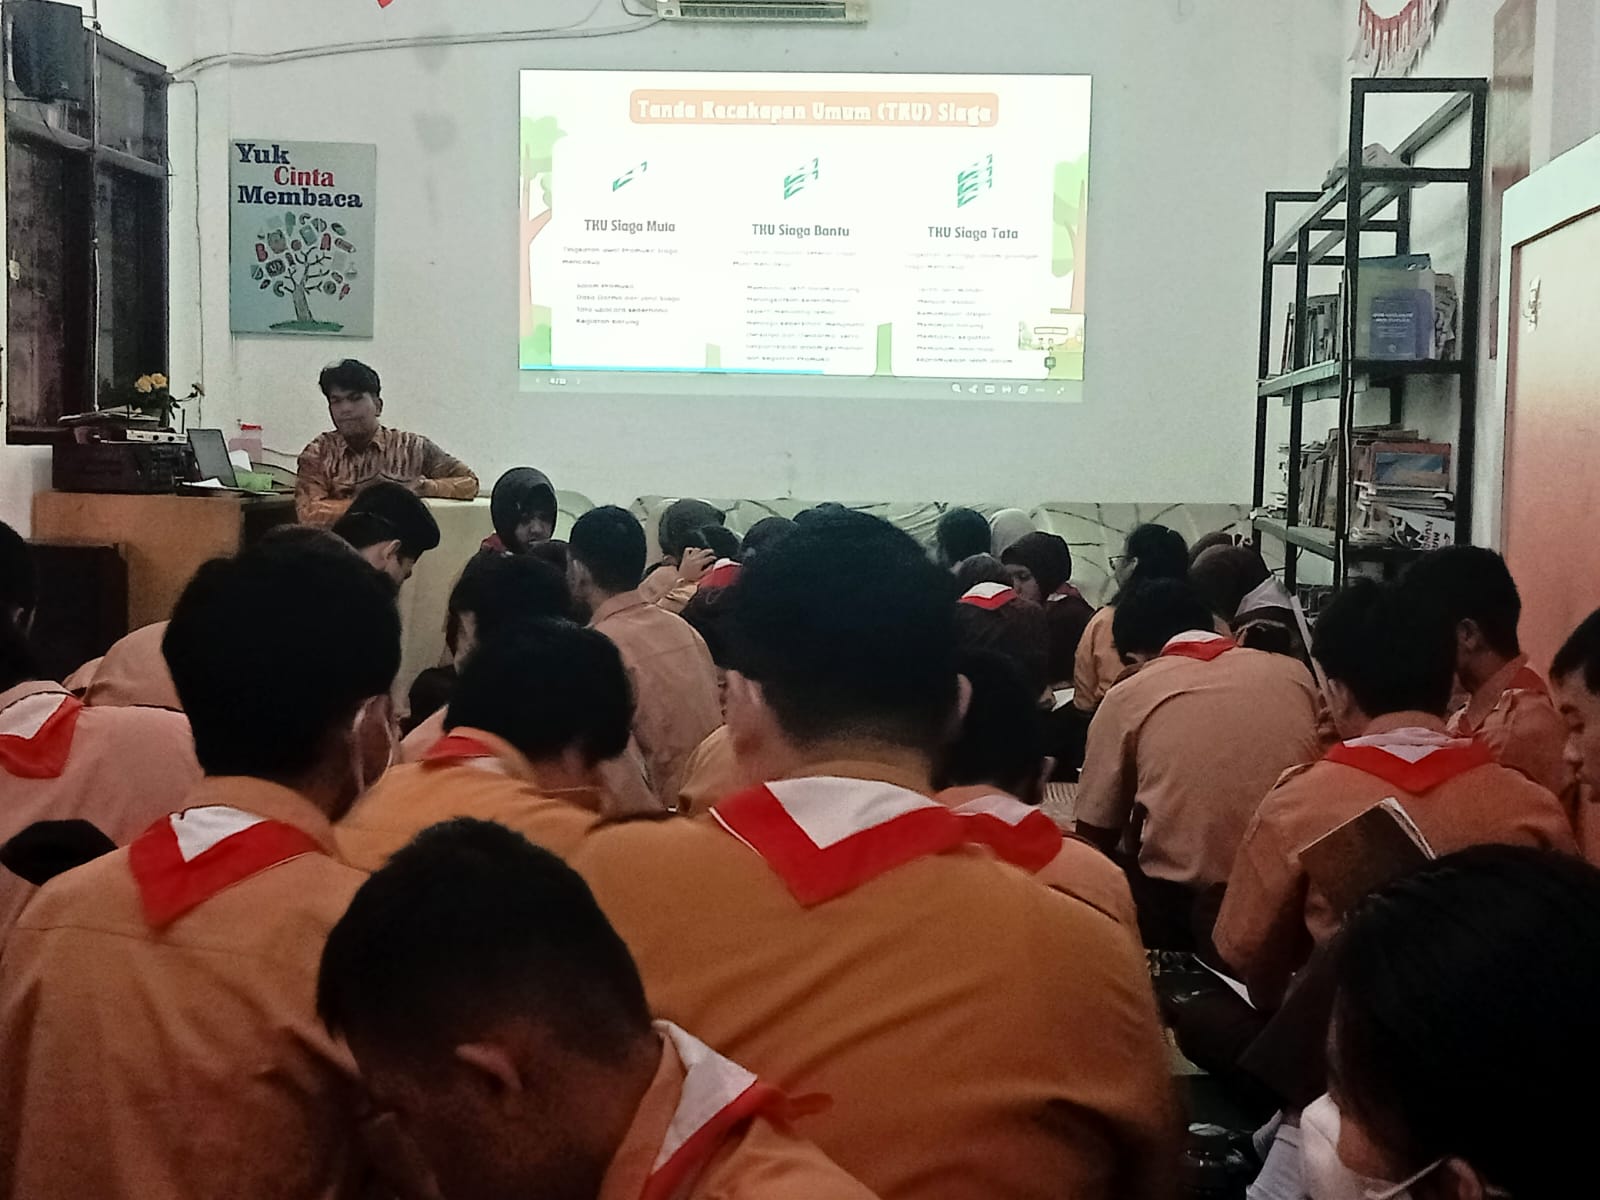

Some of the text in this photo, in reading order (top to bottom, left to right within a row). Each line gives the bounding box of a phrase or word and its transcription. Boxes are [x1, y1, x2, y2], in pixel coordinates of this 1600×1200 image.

[637, 99, 992, 126] Tanda Kecakapan Umum (TKU) Siaga
[235, 143, 291, 165] Yuk
[274, 166, 335, 187] Cinta
[237, 185, 364, 208] Membaca
[584, 219, 676, 235] TKU Siaga Mula
[752, 224, 850, 239] TKU Siaga Bantu
[928, 226, 1019, 242] TKU Siaga Tata
